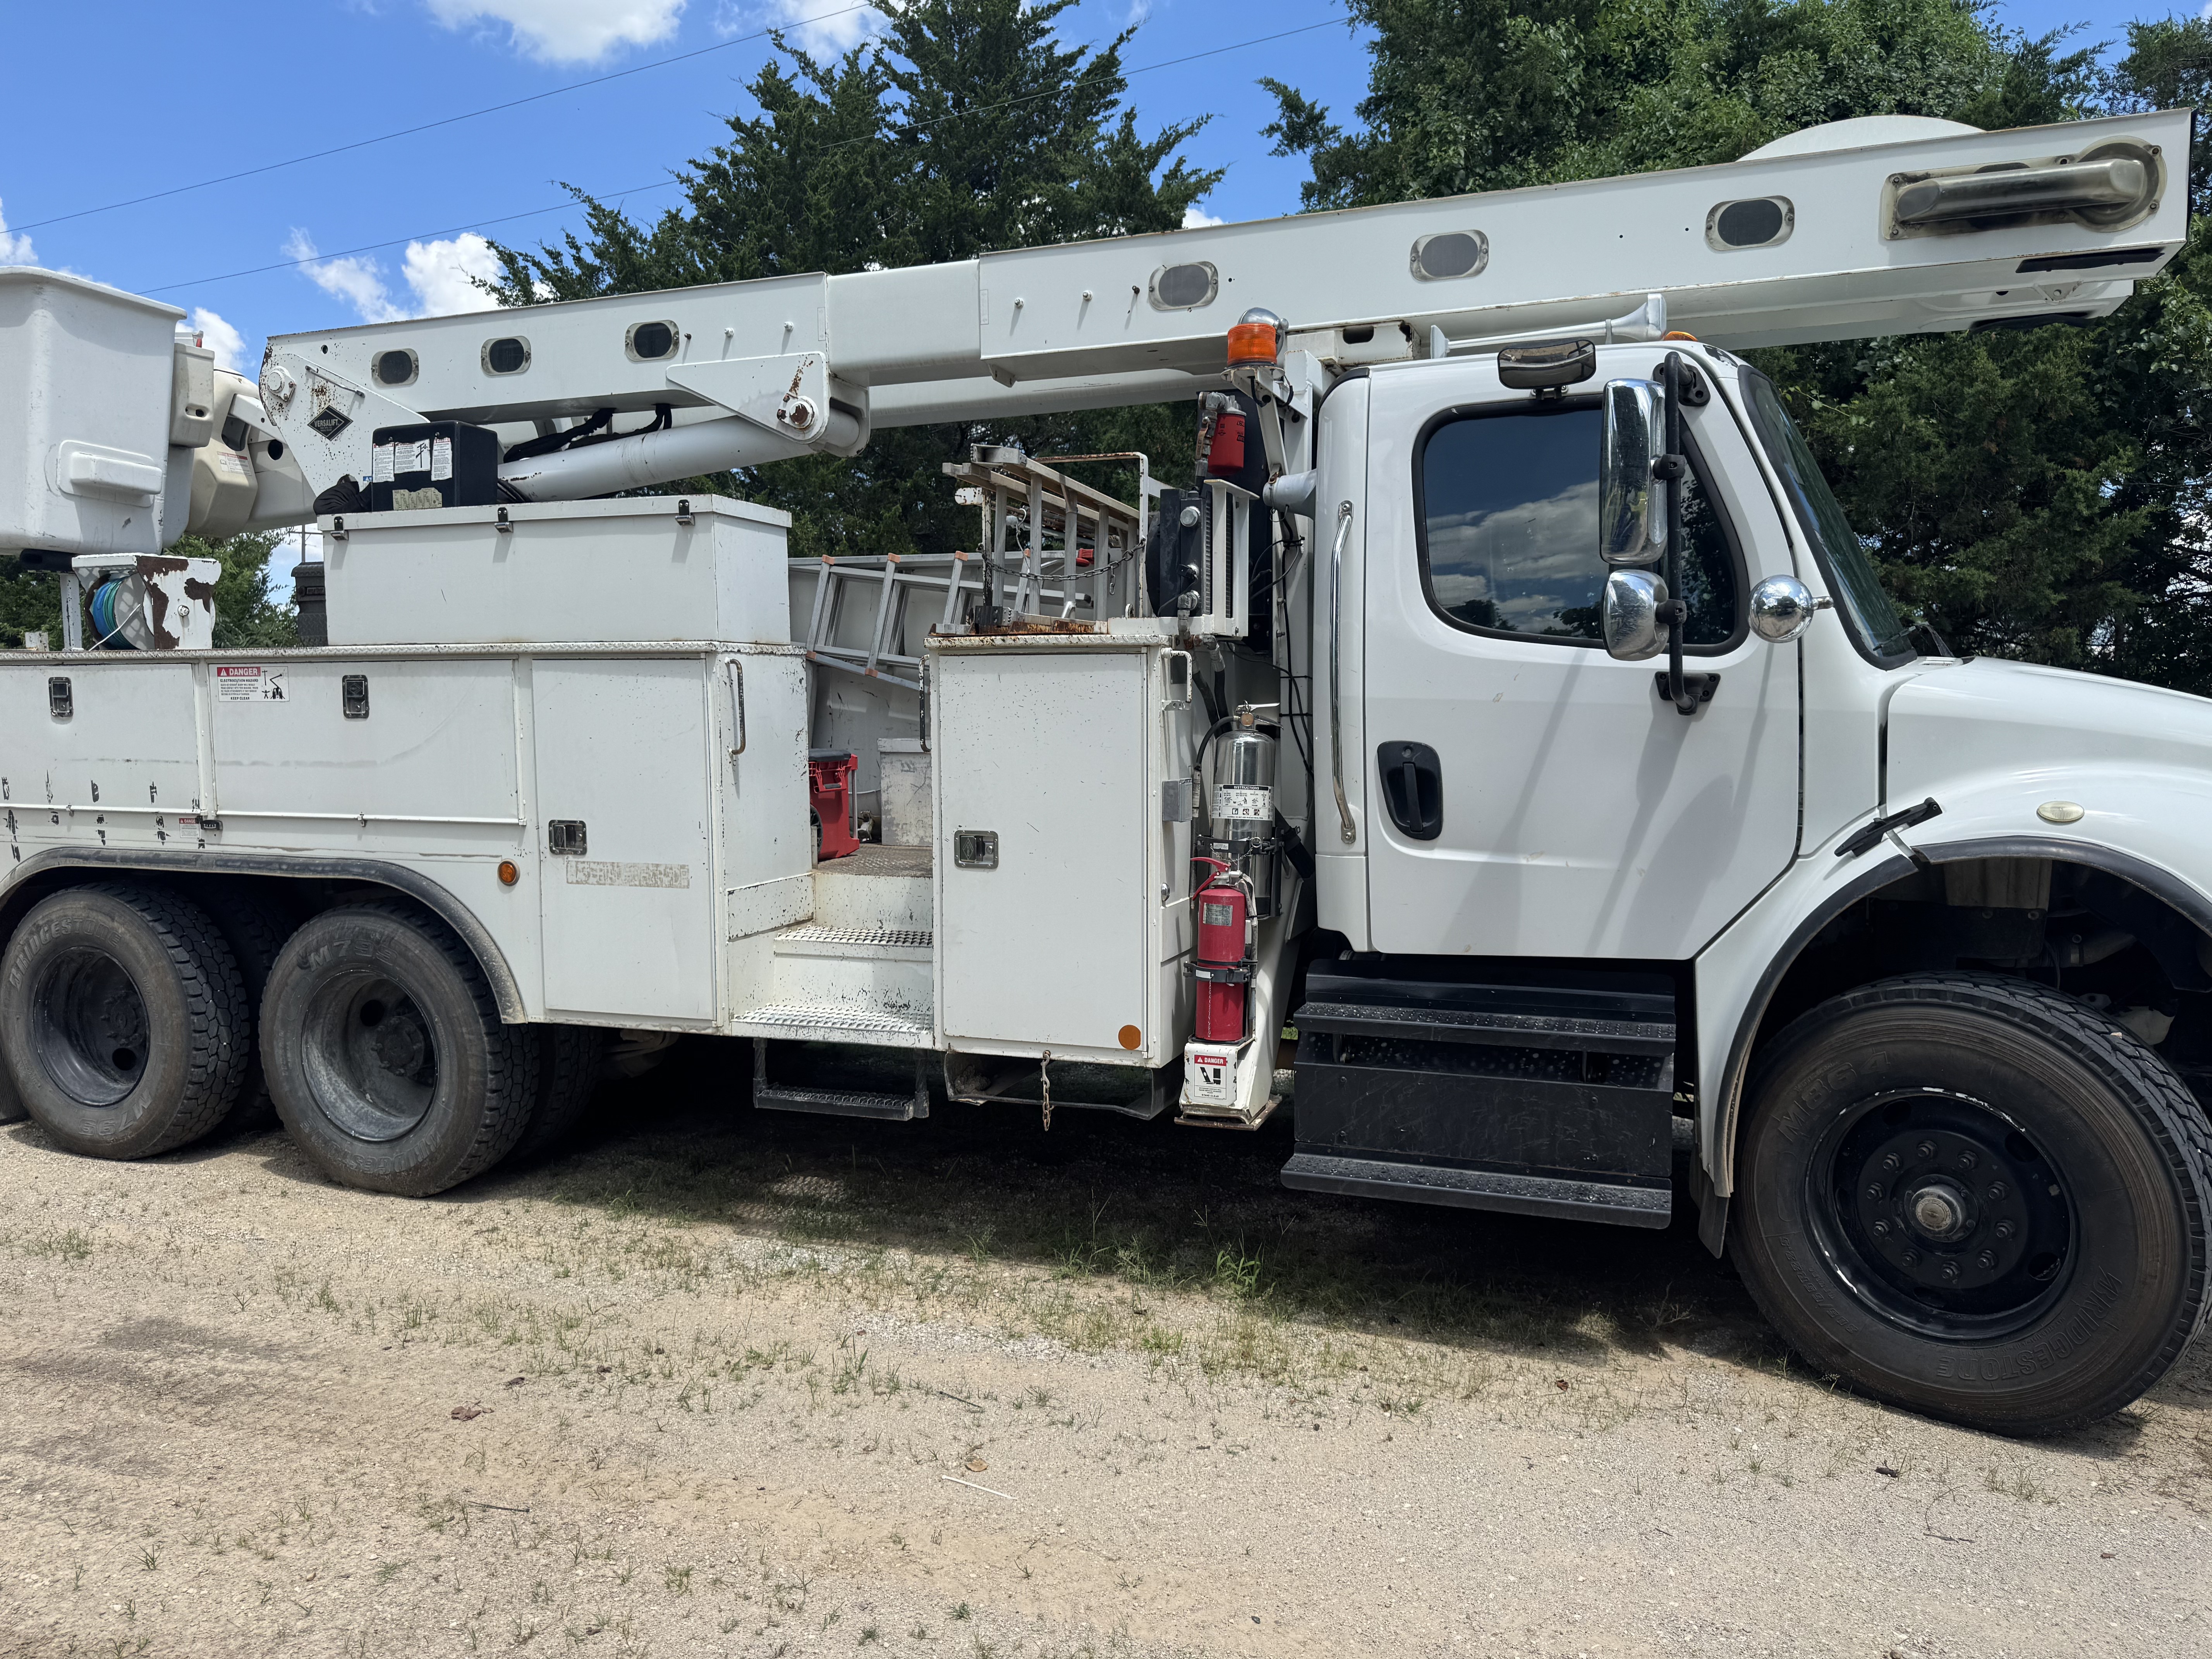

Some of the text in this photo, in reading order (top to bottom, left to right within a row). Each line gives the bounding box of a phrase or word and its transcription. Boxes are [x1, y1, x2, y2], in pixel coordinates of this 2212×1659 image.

[314, 419, 338, 428] VERSALIFT
[229, 668, 258, 676] DANGER
[9, 917, 122, 992] BRIDGESTONE
[78, 1089, 153, 1136] M799
[1936, 1265, 2122, 1381] BRIDGESTONE
